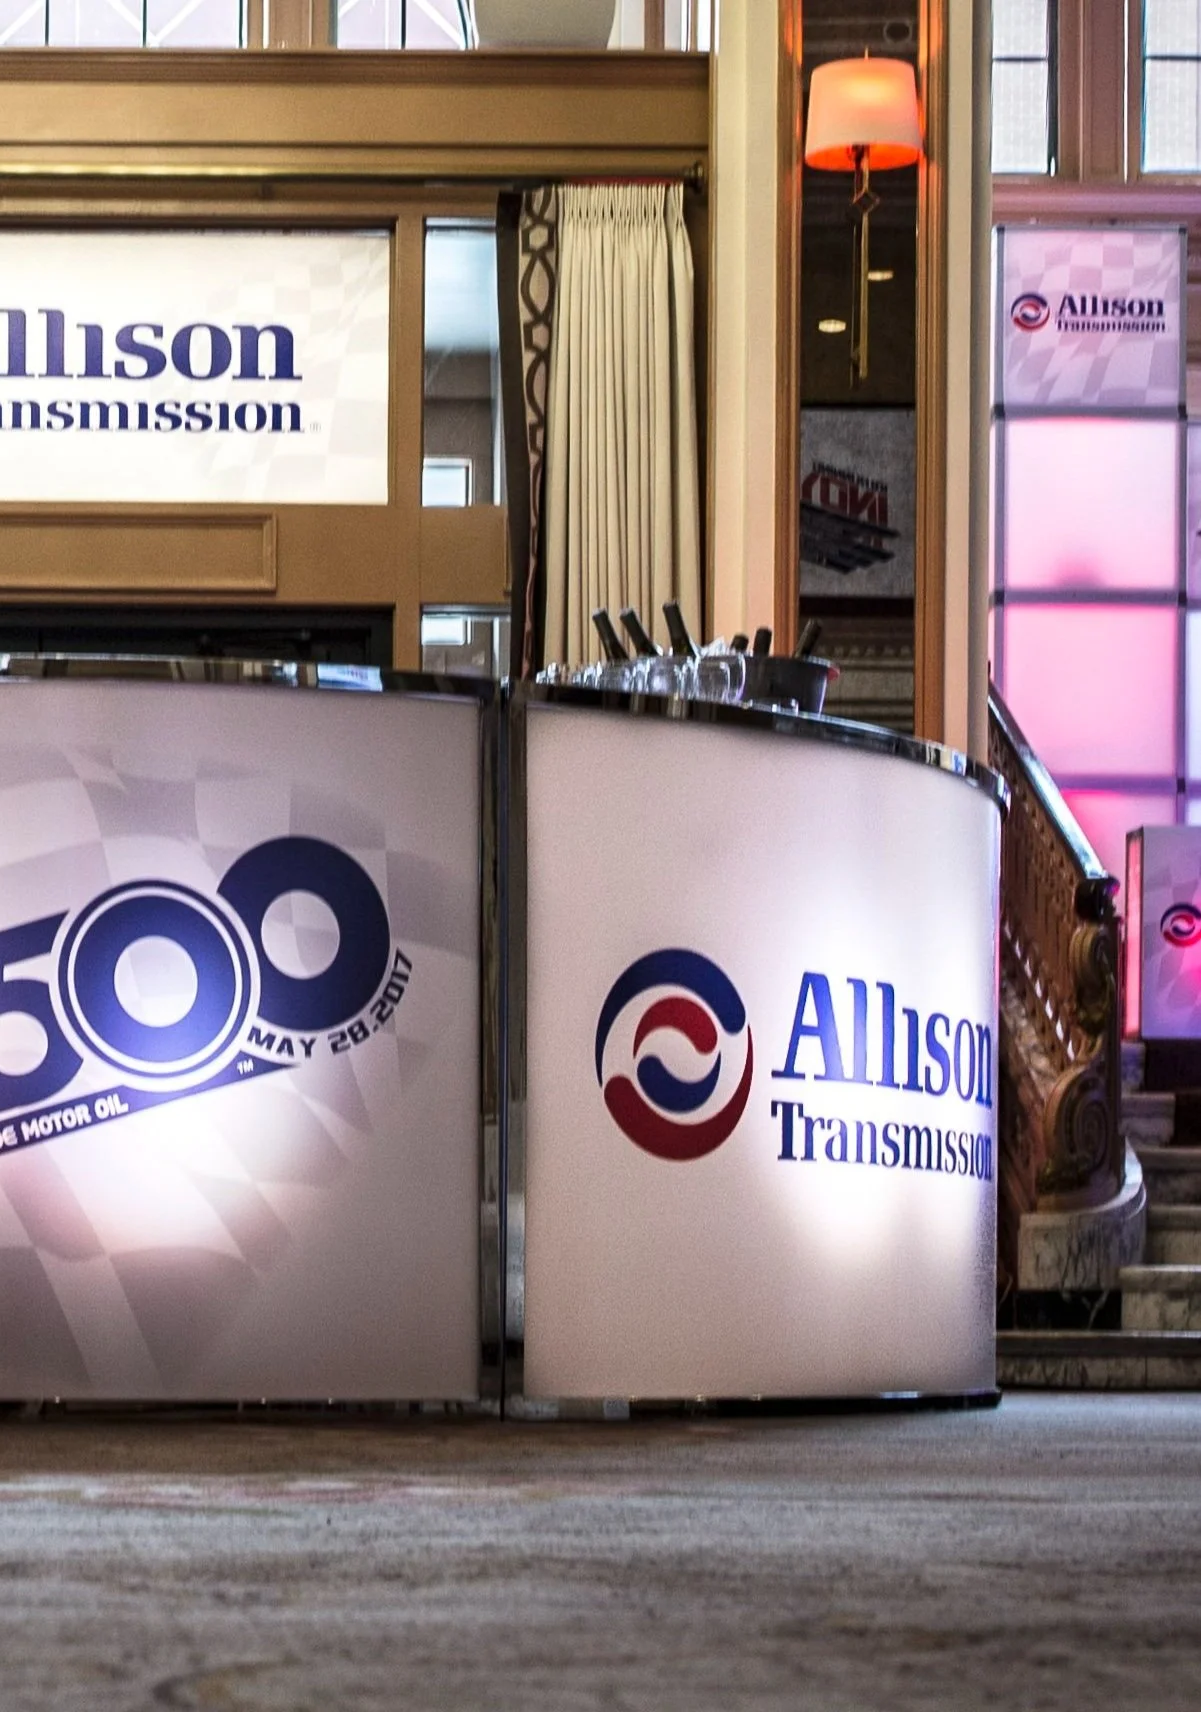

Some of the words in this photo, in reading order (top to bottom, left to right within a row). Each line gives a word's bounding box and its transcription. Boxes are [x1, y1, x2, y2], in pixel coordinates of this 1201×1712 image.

[1056, 293, 1166, 318] Allison
[247, 1027, 316, 1058] MAY
[771, 971, 993, 1109] Allison
[21, 1105, 92, 1142] MOTOR
[94, 1092, 129, 1119] OIL
[771, 1099, 993, 1182] Transmission
